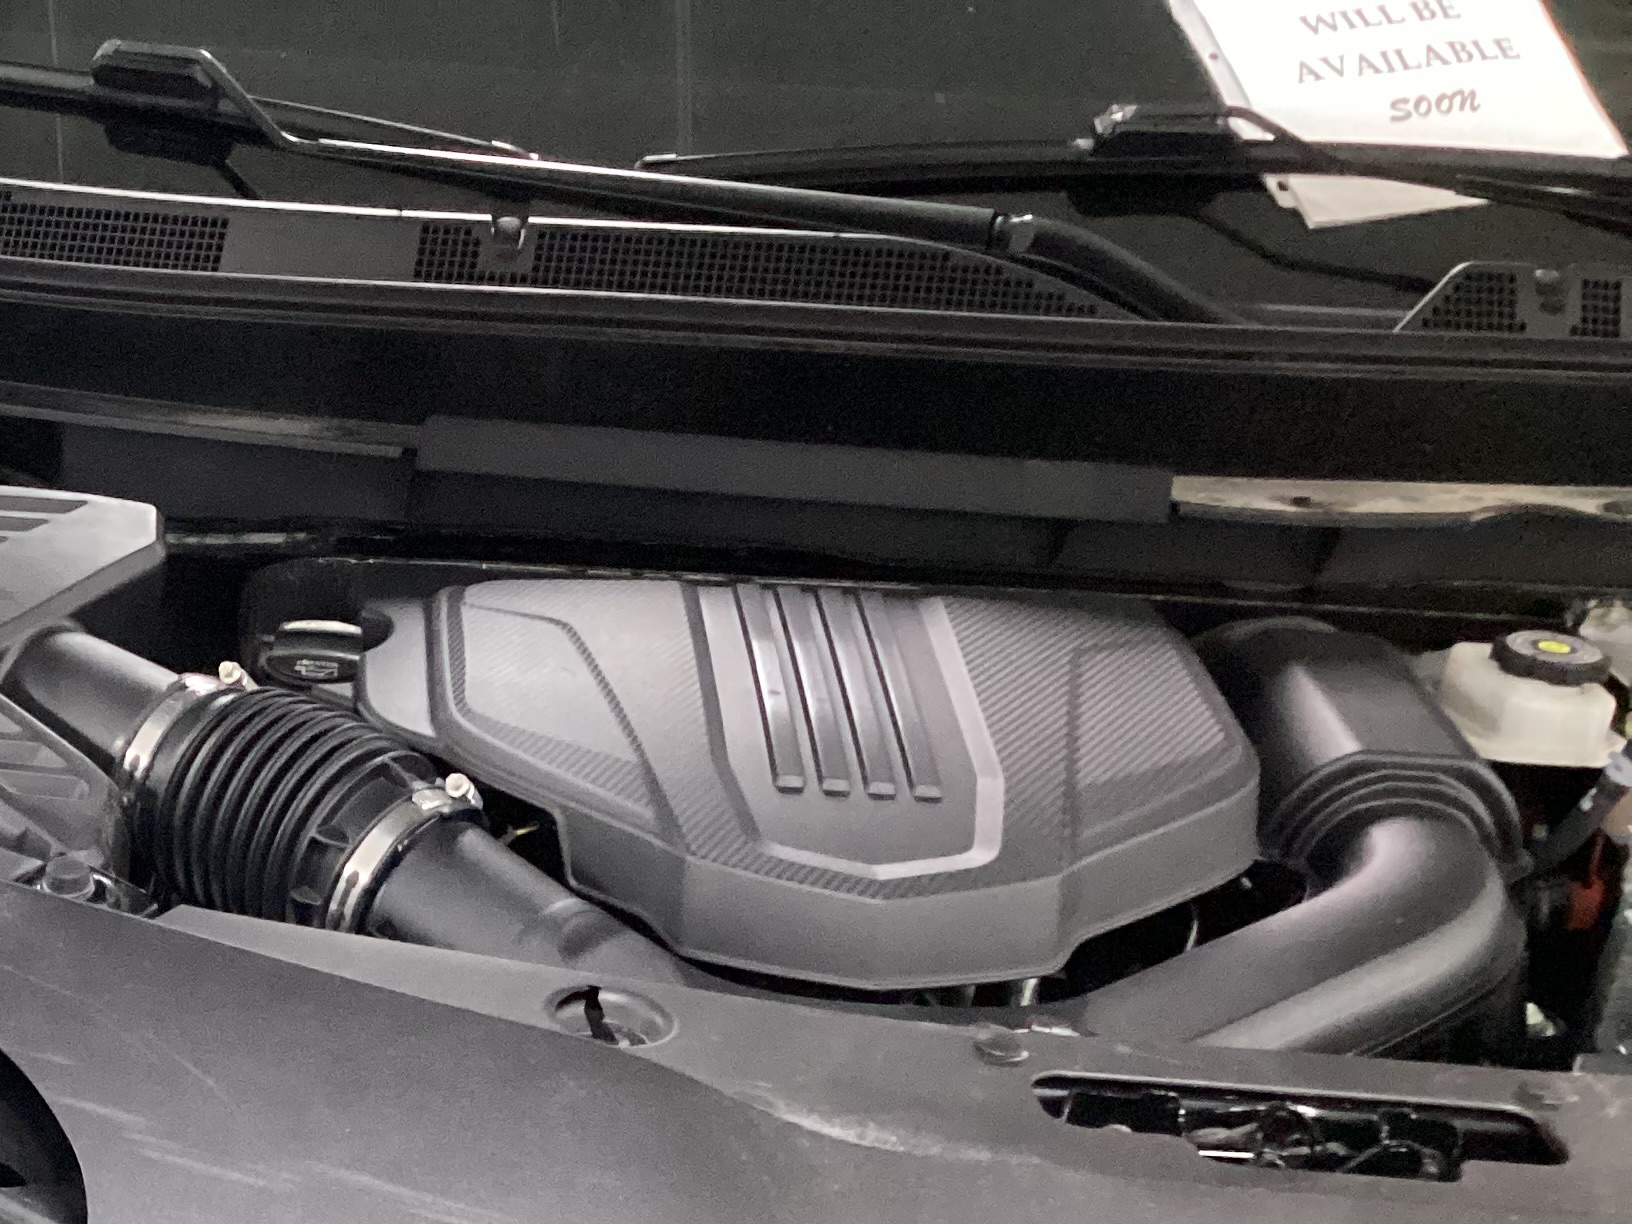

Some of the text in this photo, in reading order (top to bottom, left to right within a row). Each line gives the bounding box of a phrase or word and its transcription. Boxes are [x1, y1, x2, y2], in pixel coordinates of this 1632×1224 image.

[1299, 0, 1461, 35] WILL BE
[1298, 37, 1521, 84] AVAILABLE
[1389, 88, 1481, 123] soon
